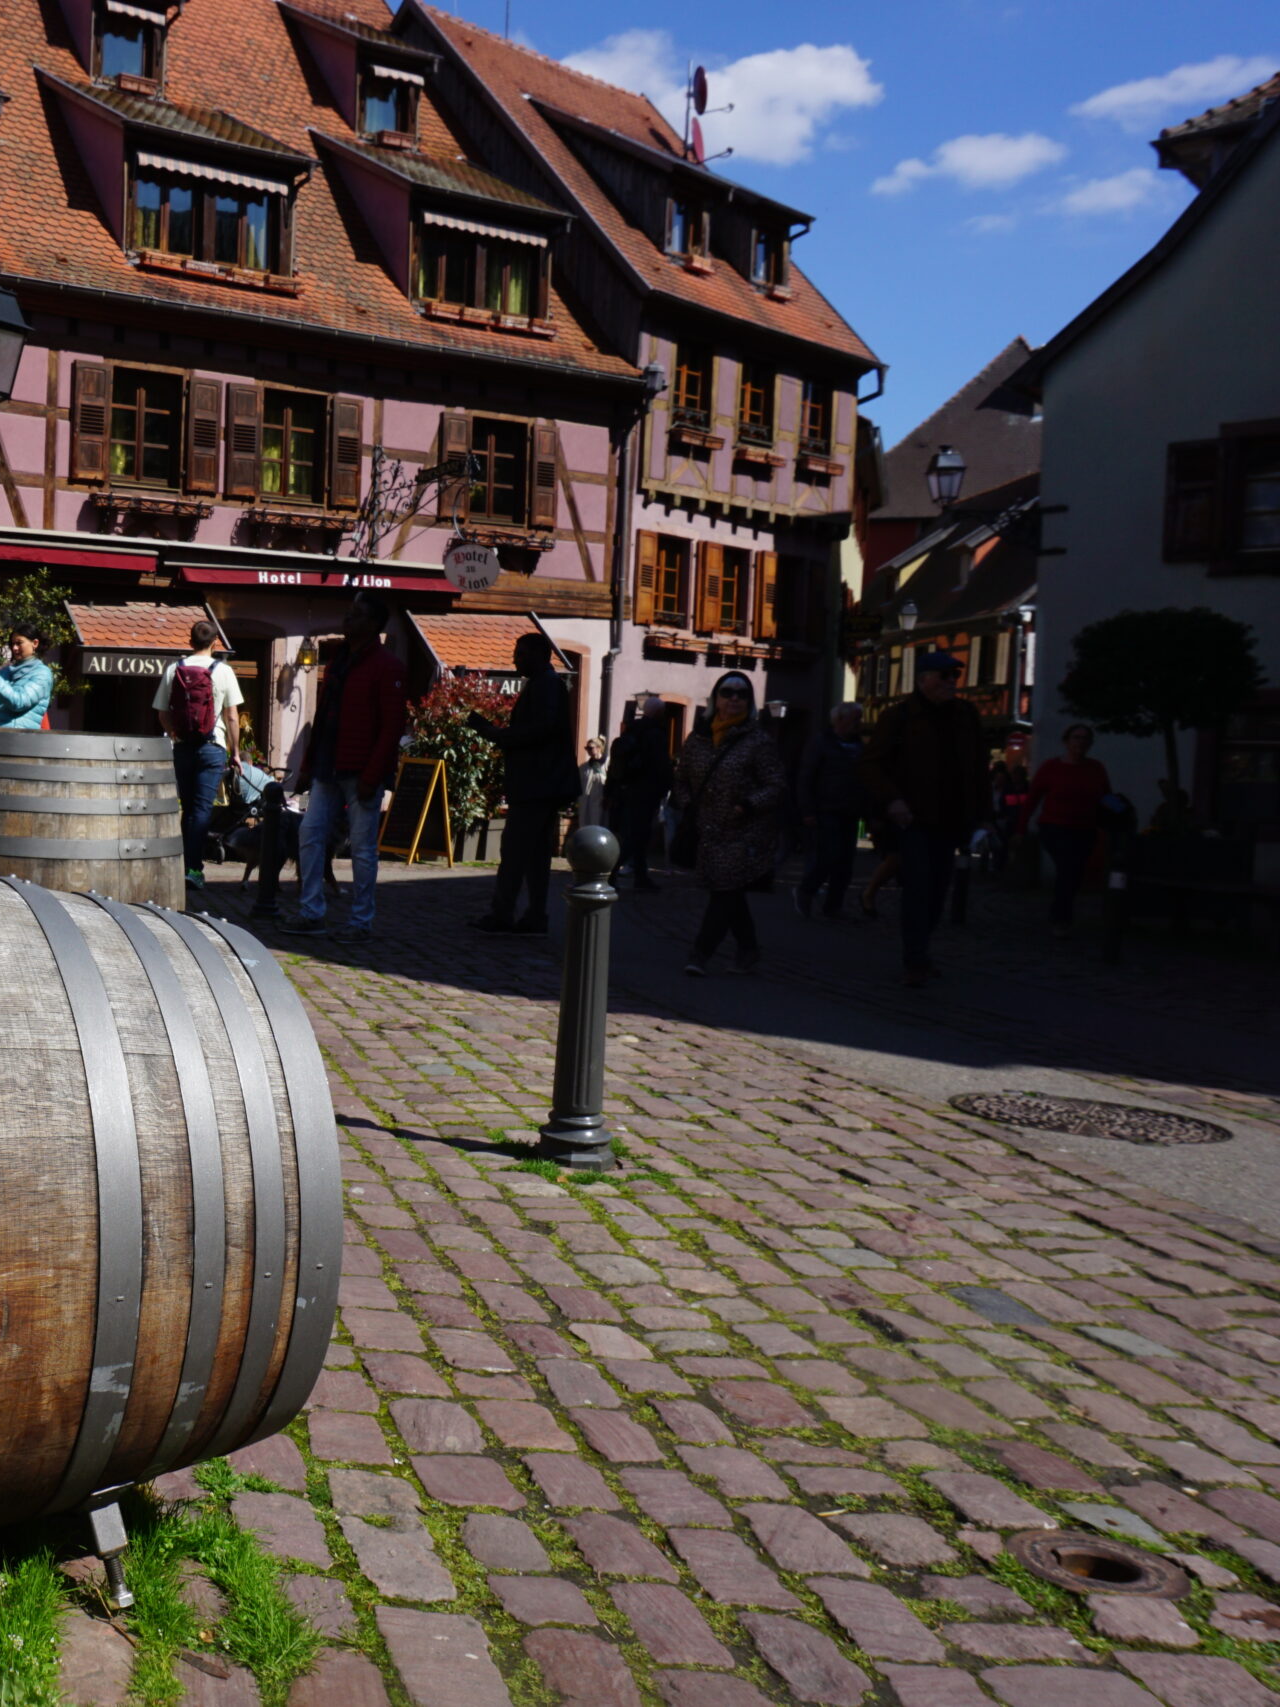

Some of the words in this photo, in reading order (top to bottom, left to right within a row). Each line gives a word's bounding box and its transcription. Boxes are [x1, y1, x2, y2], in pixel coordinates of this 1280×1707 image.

[453, 551, 489, 565] Hotel
[258, 571, 302, 585] Hotel
[363, 575, 392, 588] Lion
[457, 575, 489, 590] Lion
[88, 656, 114, 673] AU
[117, 657, 167, 675] COSY
[500, 680, 522, 695] AU
